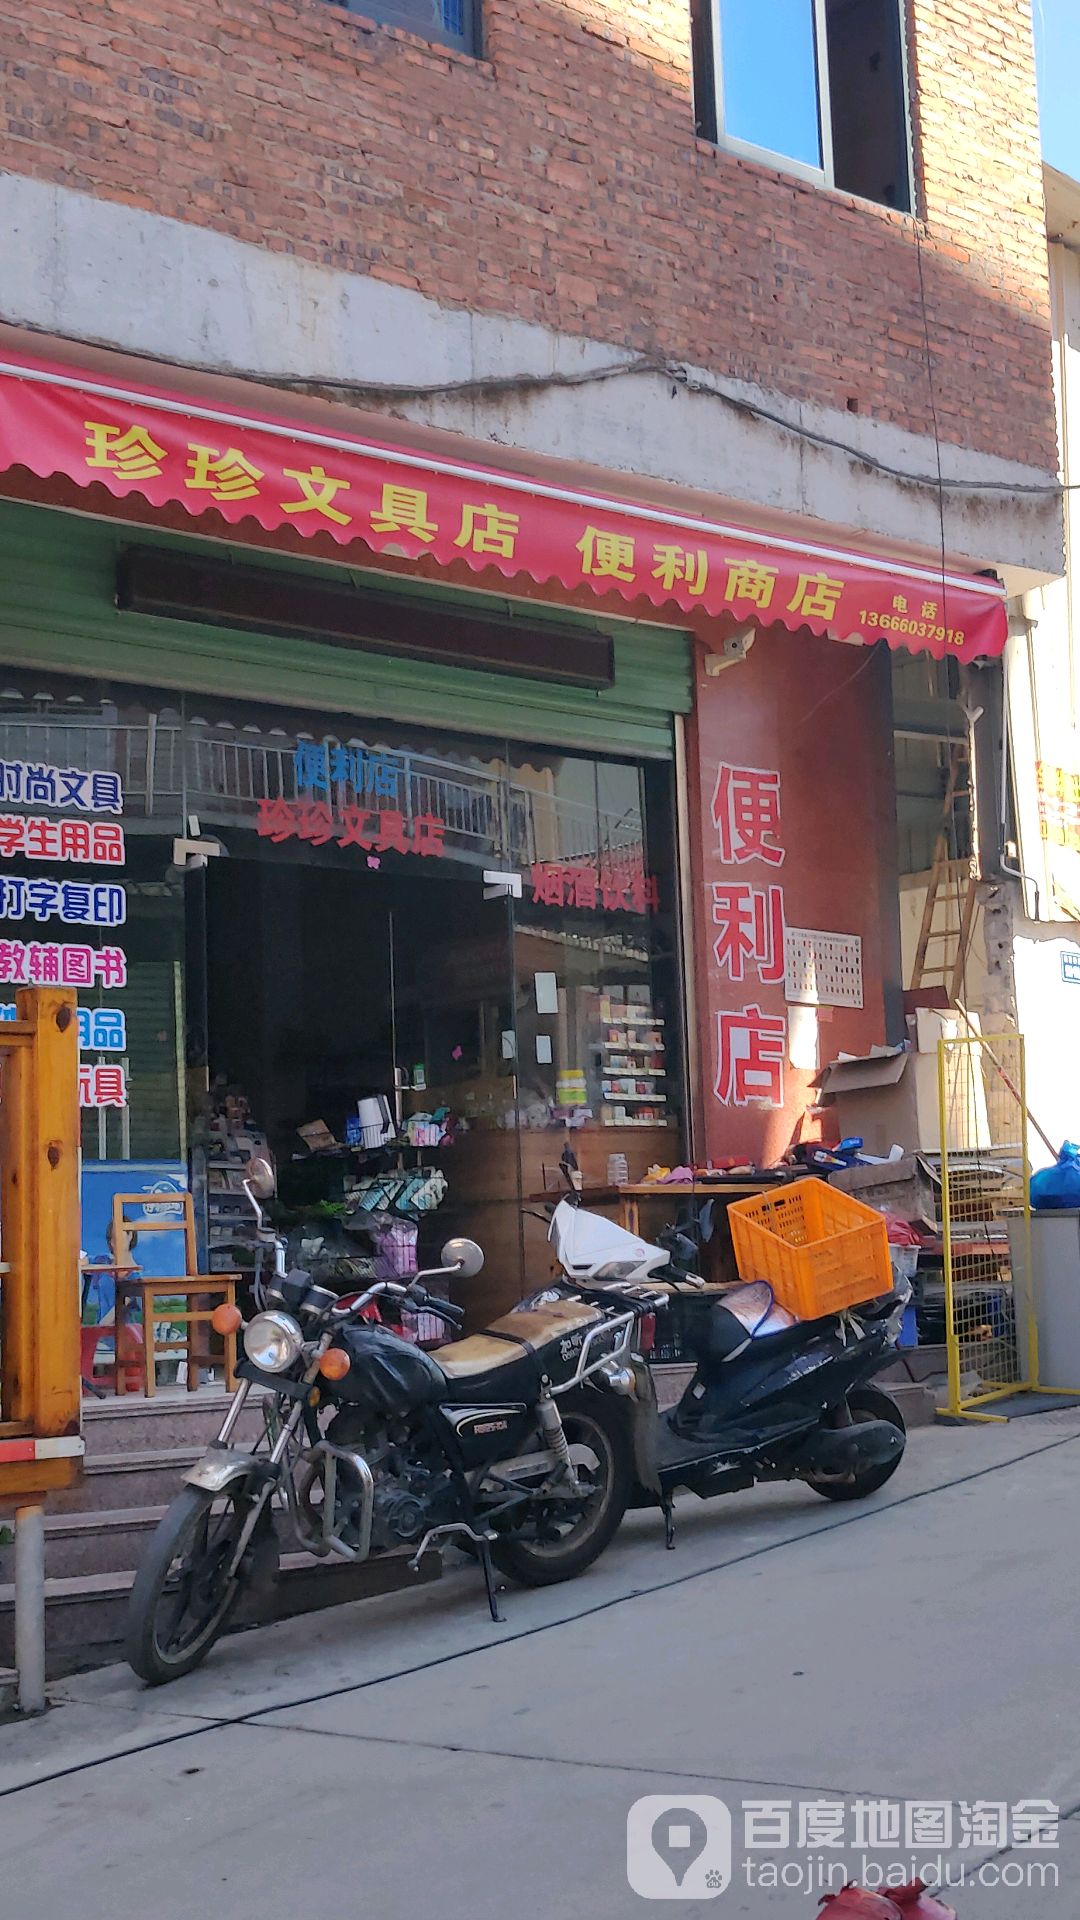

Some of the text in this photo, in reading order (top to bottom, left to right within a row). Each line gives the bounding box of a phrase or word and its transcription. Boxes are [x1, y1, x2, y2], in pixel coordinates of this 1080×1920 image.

[84, 421, 844, 621] 珍珍文具店 便利商店
[859, 610, 965, 645] 13666037918
[892, 595, 937, 620] 电话
[0, 762, 120, 811] 时尚文具
[294, 740, 401, 797] 便利店
[0, 817, 122, 862] 学生用品
[256, 797, 445, 857] 珍珍文具店
[0, 878, 123, 924] 打字复印
[713, 765, 785, 1105] 便利店
[0, 942, 124, 986] 教辅图书
